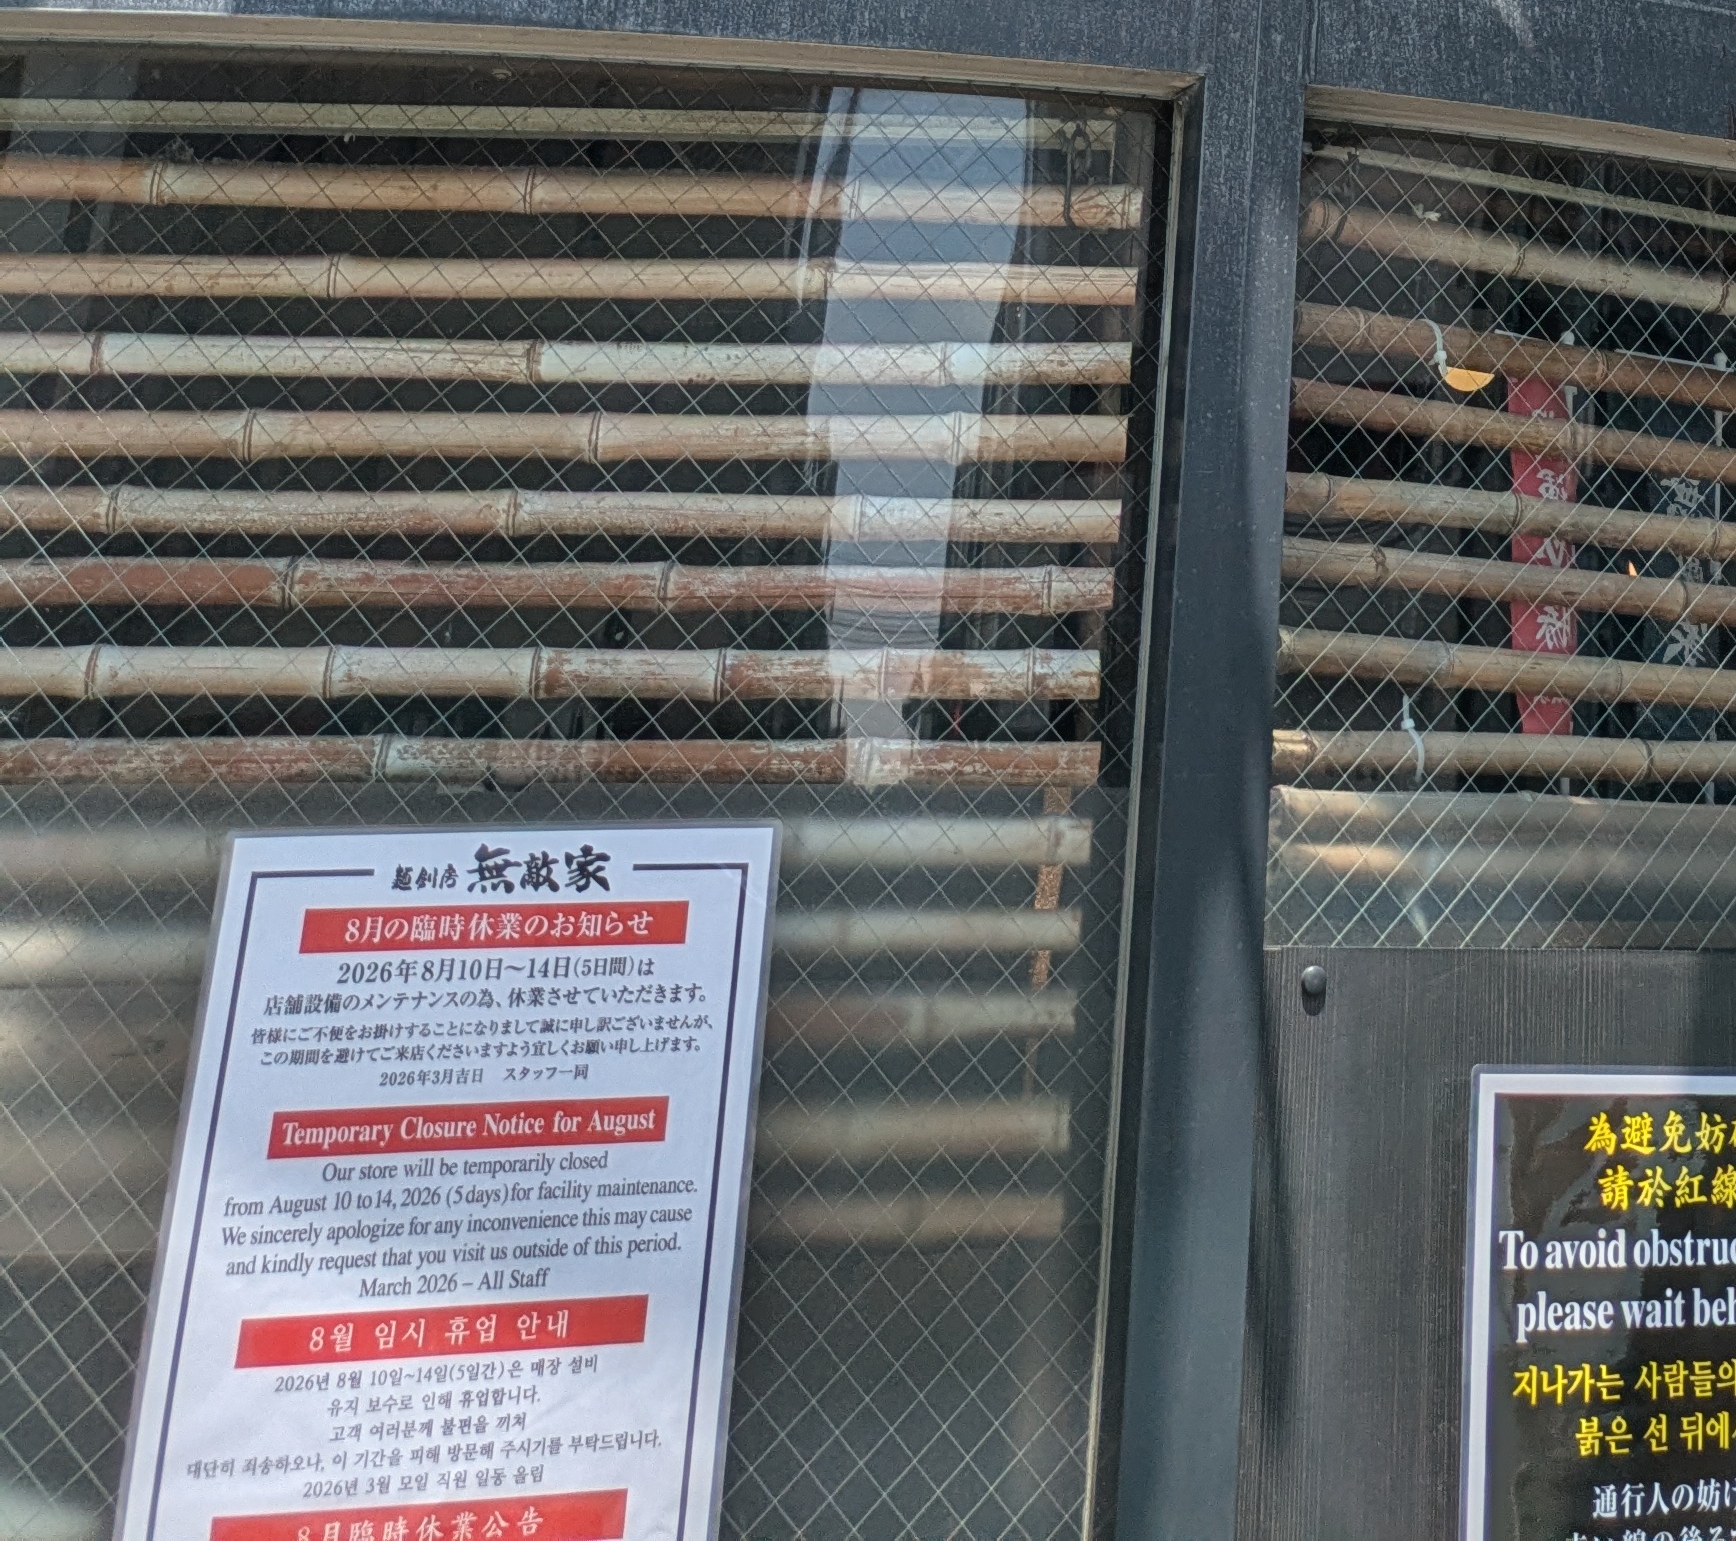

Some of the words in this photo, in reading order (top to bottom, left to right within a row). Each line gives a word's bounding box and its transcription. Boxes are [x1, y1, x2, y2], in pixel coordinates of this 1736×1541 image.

[466, 843, 611, 893] 無敵家
[345, 910, 654, 943] 8月の臨時休業のお知らせ
[263, 983, 706, 1016] 店舗設備のメンテナンスの為、休業させていただきます。
[252, 1014, 714, 1044] 皆様にご不便をお掛けすることになりまして誠に申し訳ございませんが、
[261, 1036, 700, 1066] この期間を避けてご来店くださいますよう宜しくお願い申し上げます。
[379, 1068, 484, 1086] 2026年3月吉日
[504, 1064, 589, 1082] スタッフ一同
[283, 1121, 394, 1149] Temporary
[401, 1116, 476, 1139] Closure
[483, 1112, 545, 1136] Notice
[553, 1112, 581, 1133] for
[587, 1109, 656, 1136] August
[322, 1162, 356, 1181] Our
[359, 1163, 398, 1179] store
[404, 1159, 434, 1177] will
[439, 1158, 457, 1176] be
[463, 1153, 555, 1178] temporarily
[560, 1150, 608, 1170] closed
[224, 1197, 263, 1216] from
[269, 1196, 327, 1218] August
[333, 1191, 351, 1210] 10
[401, 1186, 441, 1207] 2026
[537, 1180, 592, 1203] facility
[597, 1177, 698, 1198] maintenance.
[222, 1227, 246, 1245] We
[250, 1223, 323, 1246] sincerely
[327, 1218, 404, 1245] apologize
[408, 1216, 431, 1235] for
[434, 1218, 463, 1238] any
[467, 1210, 578, 1233] inconvenience
[583, 1208, 610, 1227] this
[614, 1210, 647, 1228] may
[650, 1208, 693, 1223] cause
[226, 1255, 257, 1276] and
[261, 1252, 314, 1276] kindly
[318, 1250, 377, 1274] request
[382, 1247, 412, 1266] that
[418, 1250, 447, 1269] you
[454, 1242, 486, 1262] visit
[491, 1245, 508, 1260] us
[513, 1238, 568, 1260] outside
[574, 1237, 592, 1255] of
[595, 1235, 623, 1254] this
[626, 1232, 682, 1258] period.
[1499, 1230, 1539, 1272] To
[1545, 1229, 1628, 1270] avoid
[359, 1277, 412, 1298] March
[417, 1273, 458, 1294] 2026
[477, 1270, 504, 1290] All
[509, 1268, 551, 1289] Staff
[309, 1322, 354, 1352] 8월
[375, 1318, 426, 1350] 임시
[445, 1314, 497, 1345] 휴업
[517, 1310, 569, 1340] 안내
[1516, 1291, 1614, 1345] please
[1620, 1288, 1686, 1328] wait
[274, 1372, 330, 1393] 2026년
[336, 1370, 362, 1389] 8월
[531, 1358, 562, 1377] 매장
[568, 1354, 599, 1374] 설비
[1512, 1364, 1625, 1407] 지나가는
[328, 1397, 359, 1417] 유지
[366, 1395, 413, 1413] 보수로
[422, 1391, 451, 1410] 인해
[459, 1385, 540, 1408] 휴업합니다.
[330, 1424, 362, 1442] 고객
[370, 1419, 435, 1440] 여러분께
[441, 1415, 489, 1436] 불편을
[1575, 1418, 1632, 1457] 붉은
[1643, 1414, 1670, 1454] 선
[333, 1451, 348, 1471] 이
[355, 1448, 403, 1468] 기간을
[410, 1445, 441, 1464] 피해
[448, 1441, 495, 1462] 방문해
[500, 1437, 563, 1459] 주시기를
[568, 1429, 662, 1454] 부탁드립니다.
[303, 1477, 359, 1499] 2026년
[365, 1475, 391, 1495] 3월
[398, 1472, 429, 1491] 모일
[437, 1470, 467, 1490] 직원
[476, 1467, 506, 1487] 일동
[513, 1464, 544, 1484] 올림
